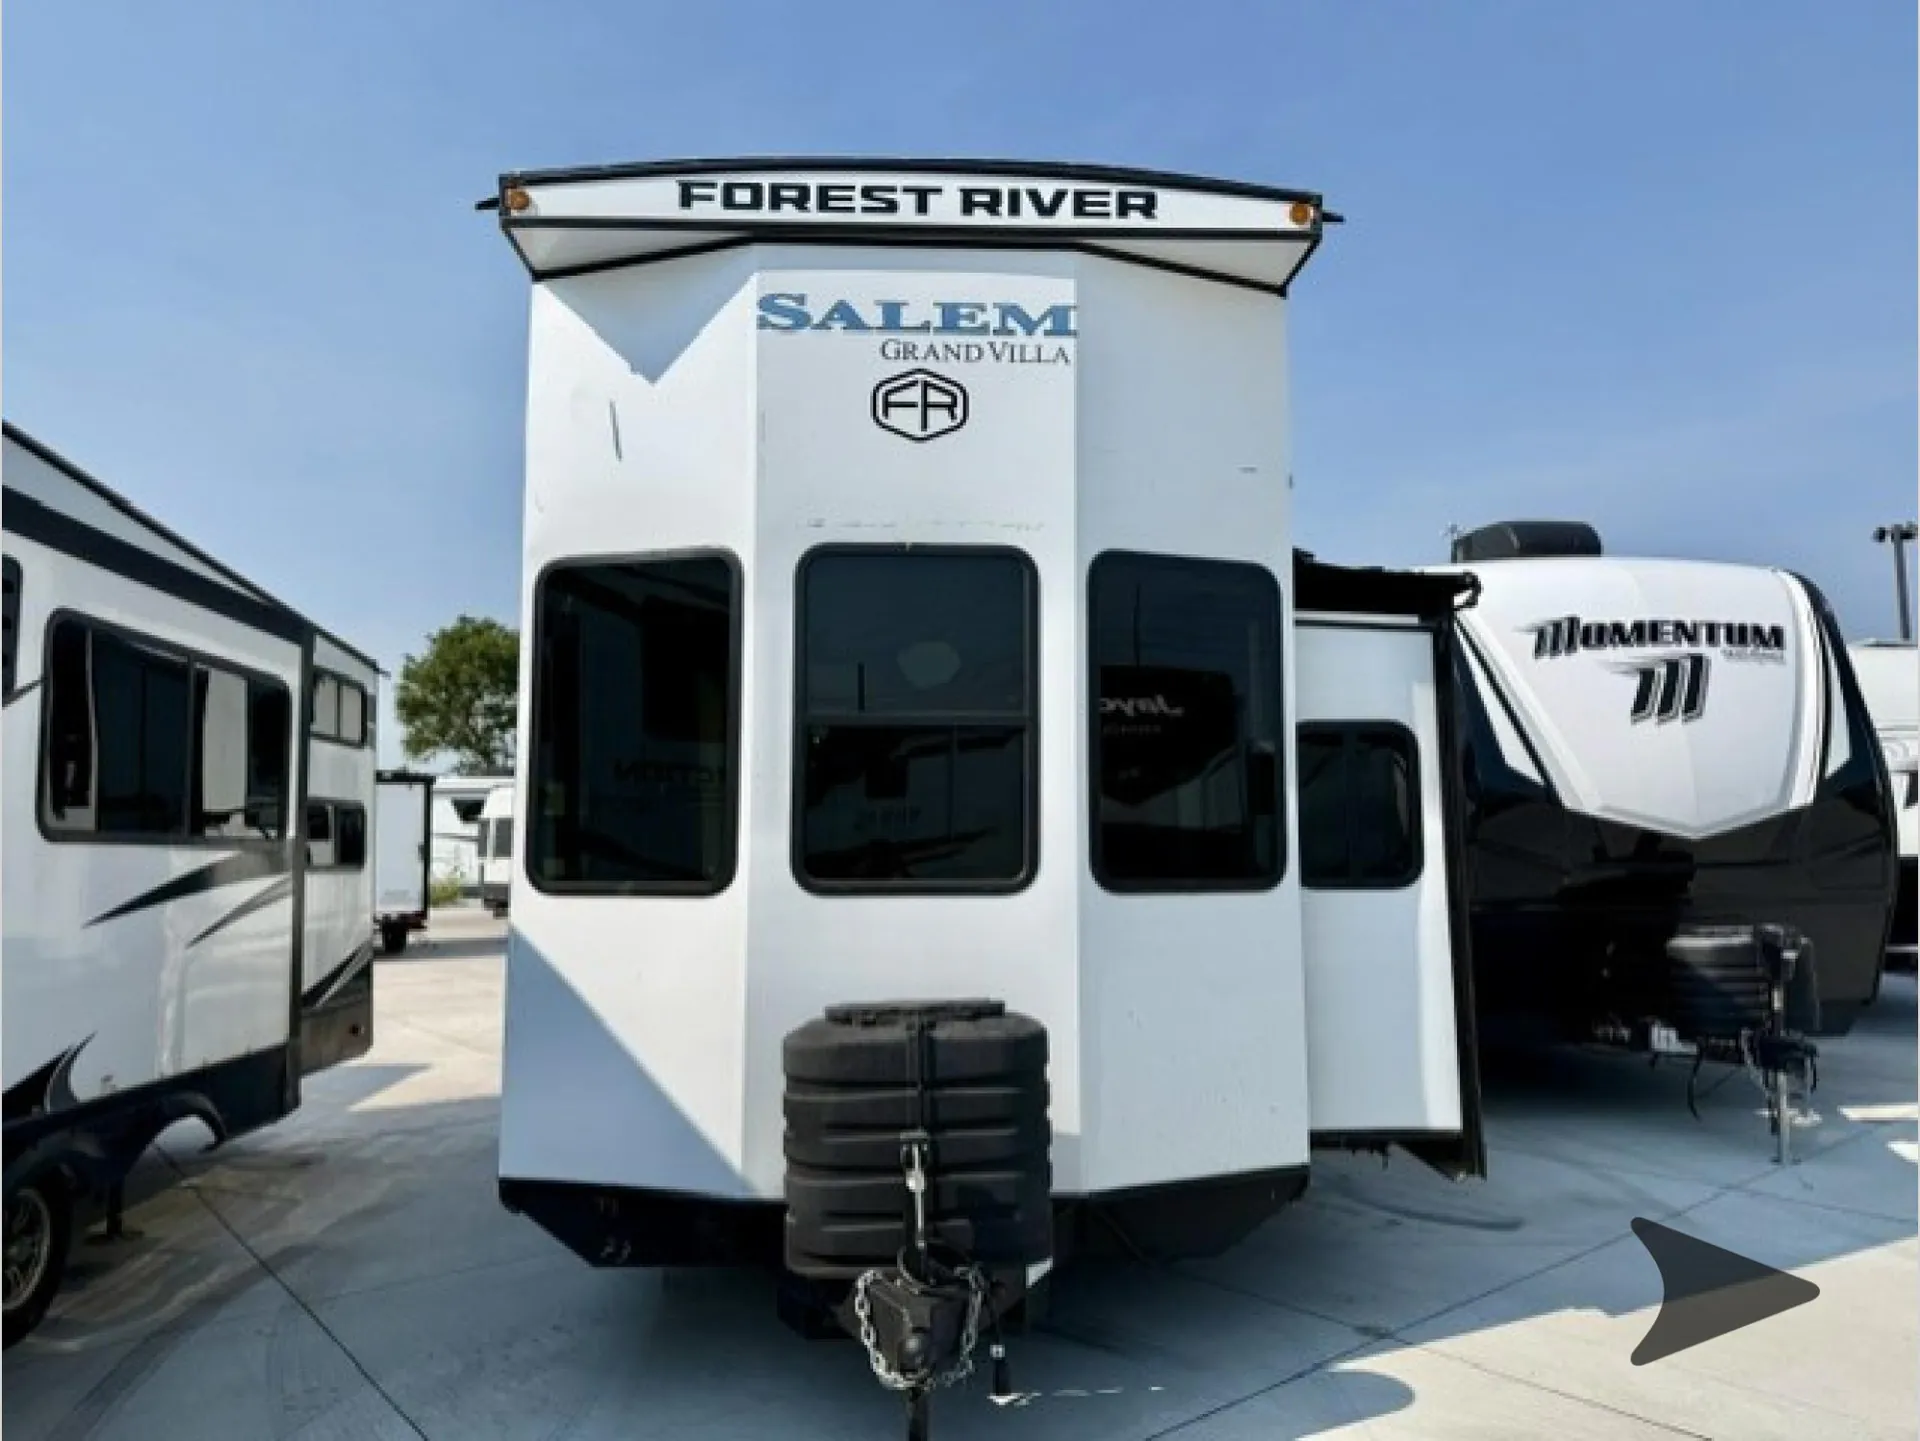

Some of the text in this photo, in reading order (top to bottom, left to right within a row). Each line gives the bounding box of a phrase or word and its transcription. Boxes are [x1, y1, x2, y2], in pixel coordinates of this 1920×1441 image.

[678, 180, 1158, 220] FOREST RIVER
[757, 293, 1077, 337] SALEM
[880, 338, 1070, 365] GRAND VILLA
[1526, 615, 1785, 659] MOMENTUM
